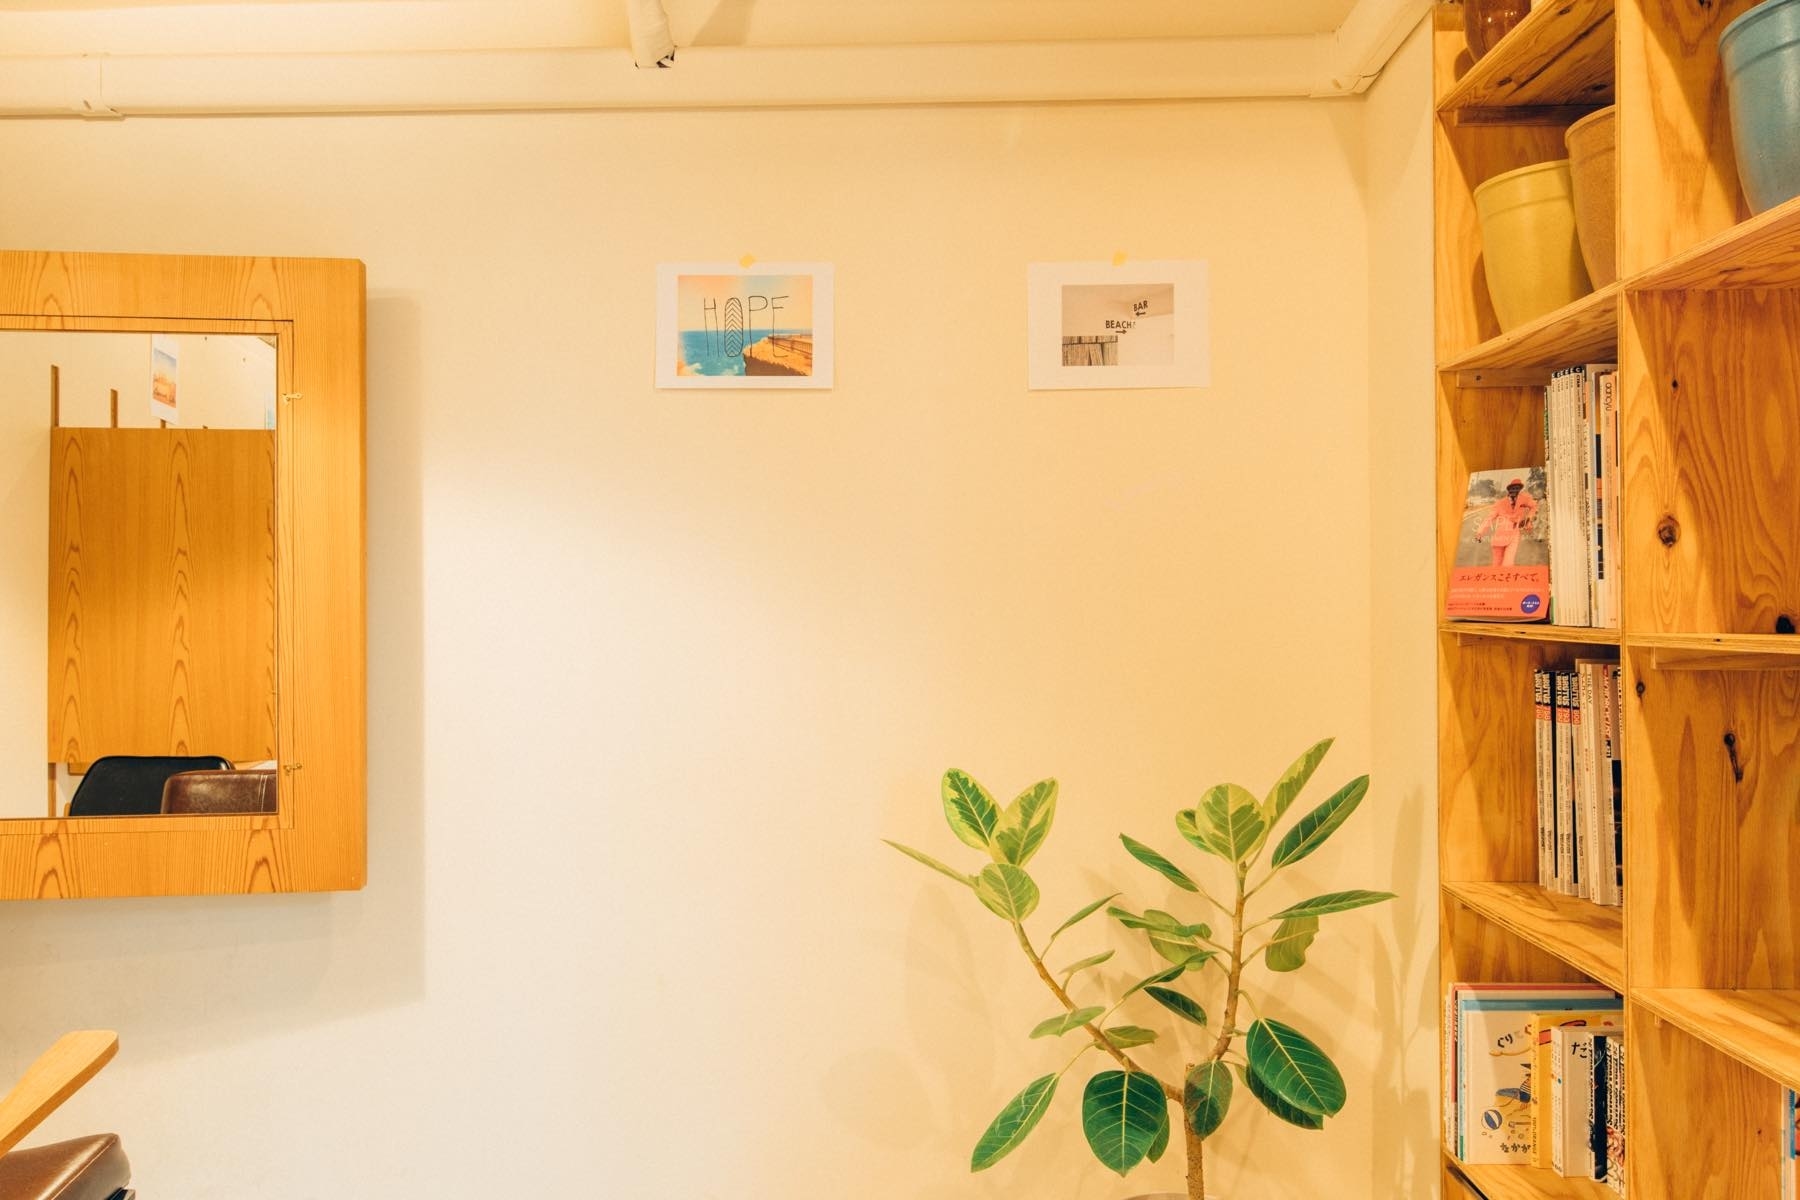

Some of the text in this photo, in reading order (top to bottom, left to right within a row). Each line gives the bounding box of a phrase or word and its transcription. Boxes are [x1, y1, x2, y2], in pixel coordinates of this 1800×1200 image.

[1133, 300, 1148, 312] BAR
[703, 295, 789, 358] HOPE
[1562, 675, 1570, 706] BRUTUS
